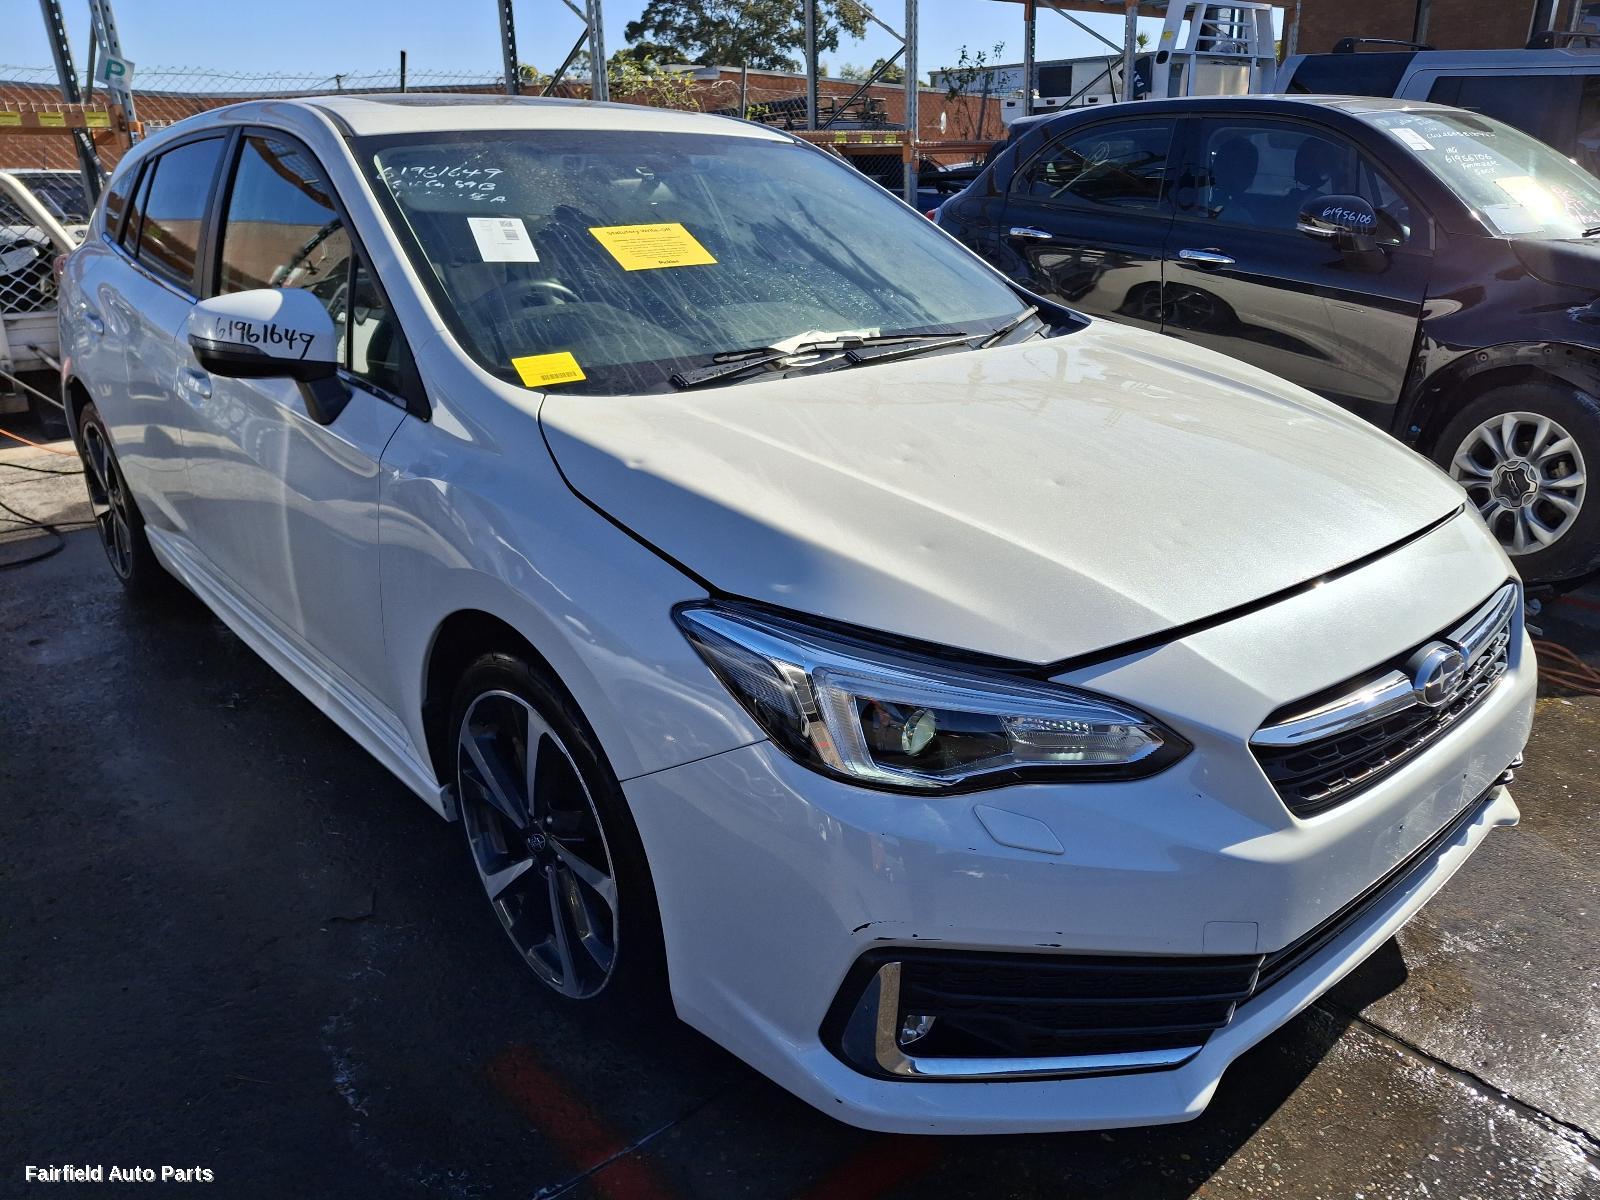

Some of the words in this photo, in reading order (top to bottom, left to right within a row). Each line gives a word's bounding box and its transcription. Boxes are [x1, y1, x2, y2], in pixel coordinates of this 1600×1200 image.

[104, 59, 126, 80] P
[1322, 206, 1372, 225] 61956106
[215, 317, 315, 360] 61961649
